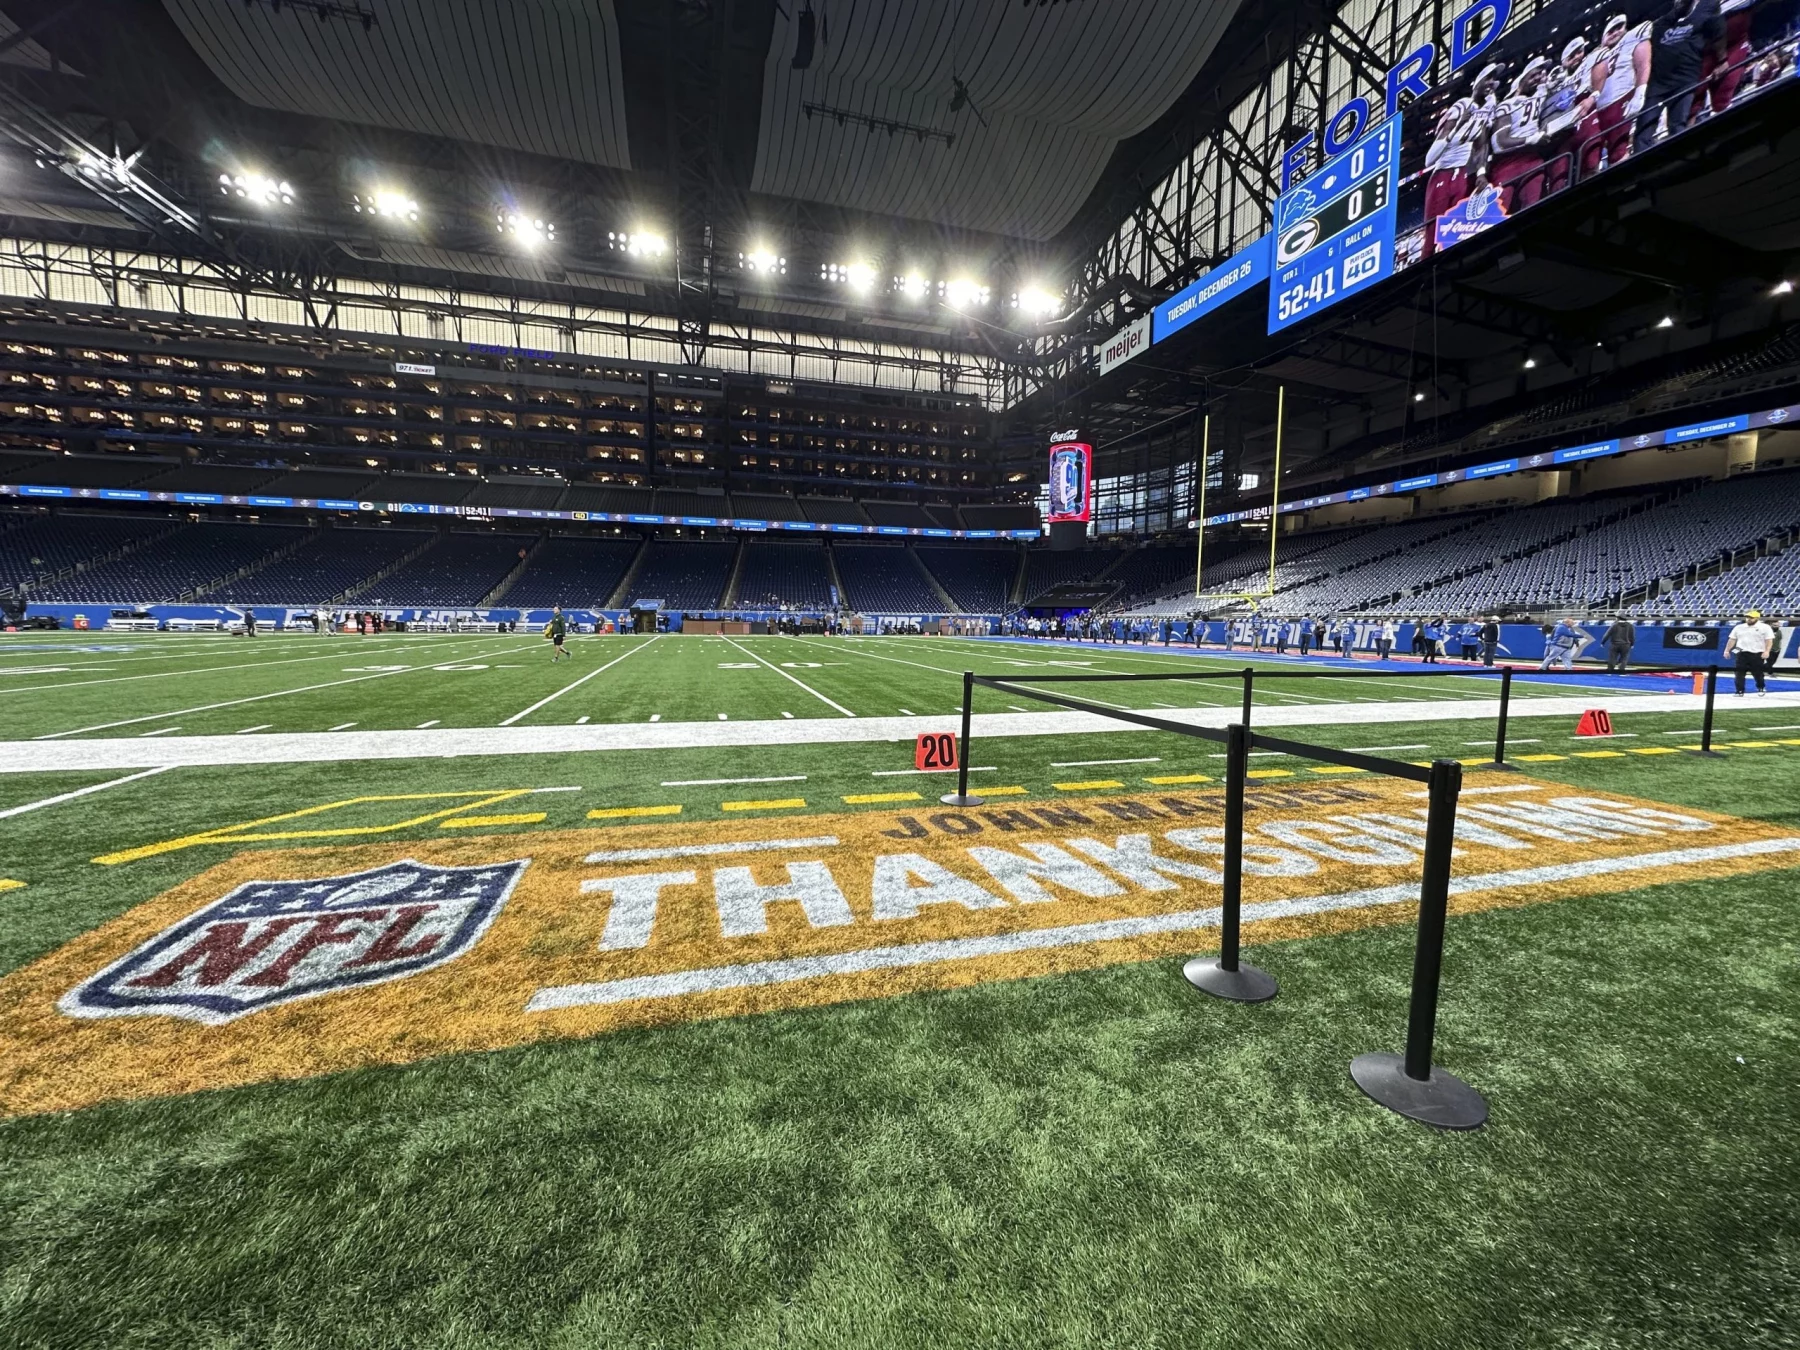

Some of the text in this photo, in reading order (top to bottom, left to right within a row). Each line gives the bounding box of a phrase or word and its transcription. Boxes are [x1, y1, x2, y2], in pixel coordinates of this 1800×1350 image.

[1282, 0, 1512, 194] FORD
[1350, 149, 1364, 180] 0
[1347, 190, 1363, 221] 0
[1345, 231, 1360, 248] BALL
[1361, 224, 1373, 239] ON
[1282, 270, 1294, 283] QTR
[1346, 255, 1376, 280] 40
[1167, 260, 1252, 323] TUESDAY, DECEMBER 26
[1278, 266, 1336, 321] 52:41
[469, 343, 554, 360] FORD FIELD
[1105, 328, 1143, 364] meijer
[465, 506, 488, 516] 52:41
[1253, 507, 1268, 517] 52:41
[1589, 710, 1610, 734] 10
[921, 734, 954, 768] 20
[878, 804, 1095, 839] JOHN
[124, 903, 443, 988] NFL
